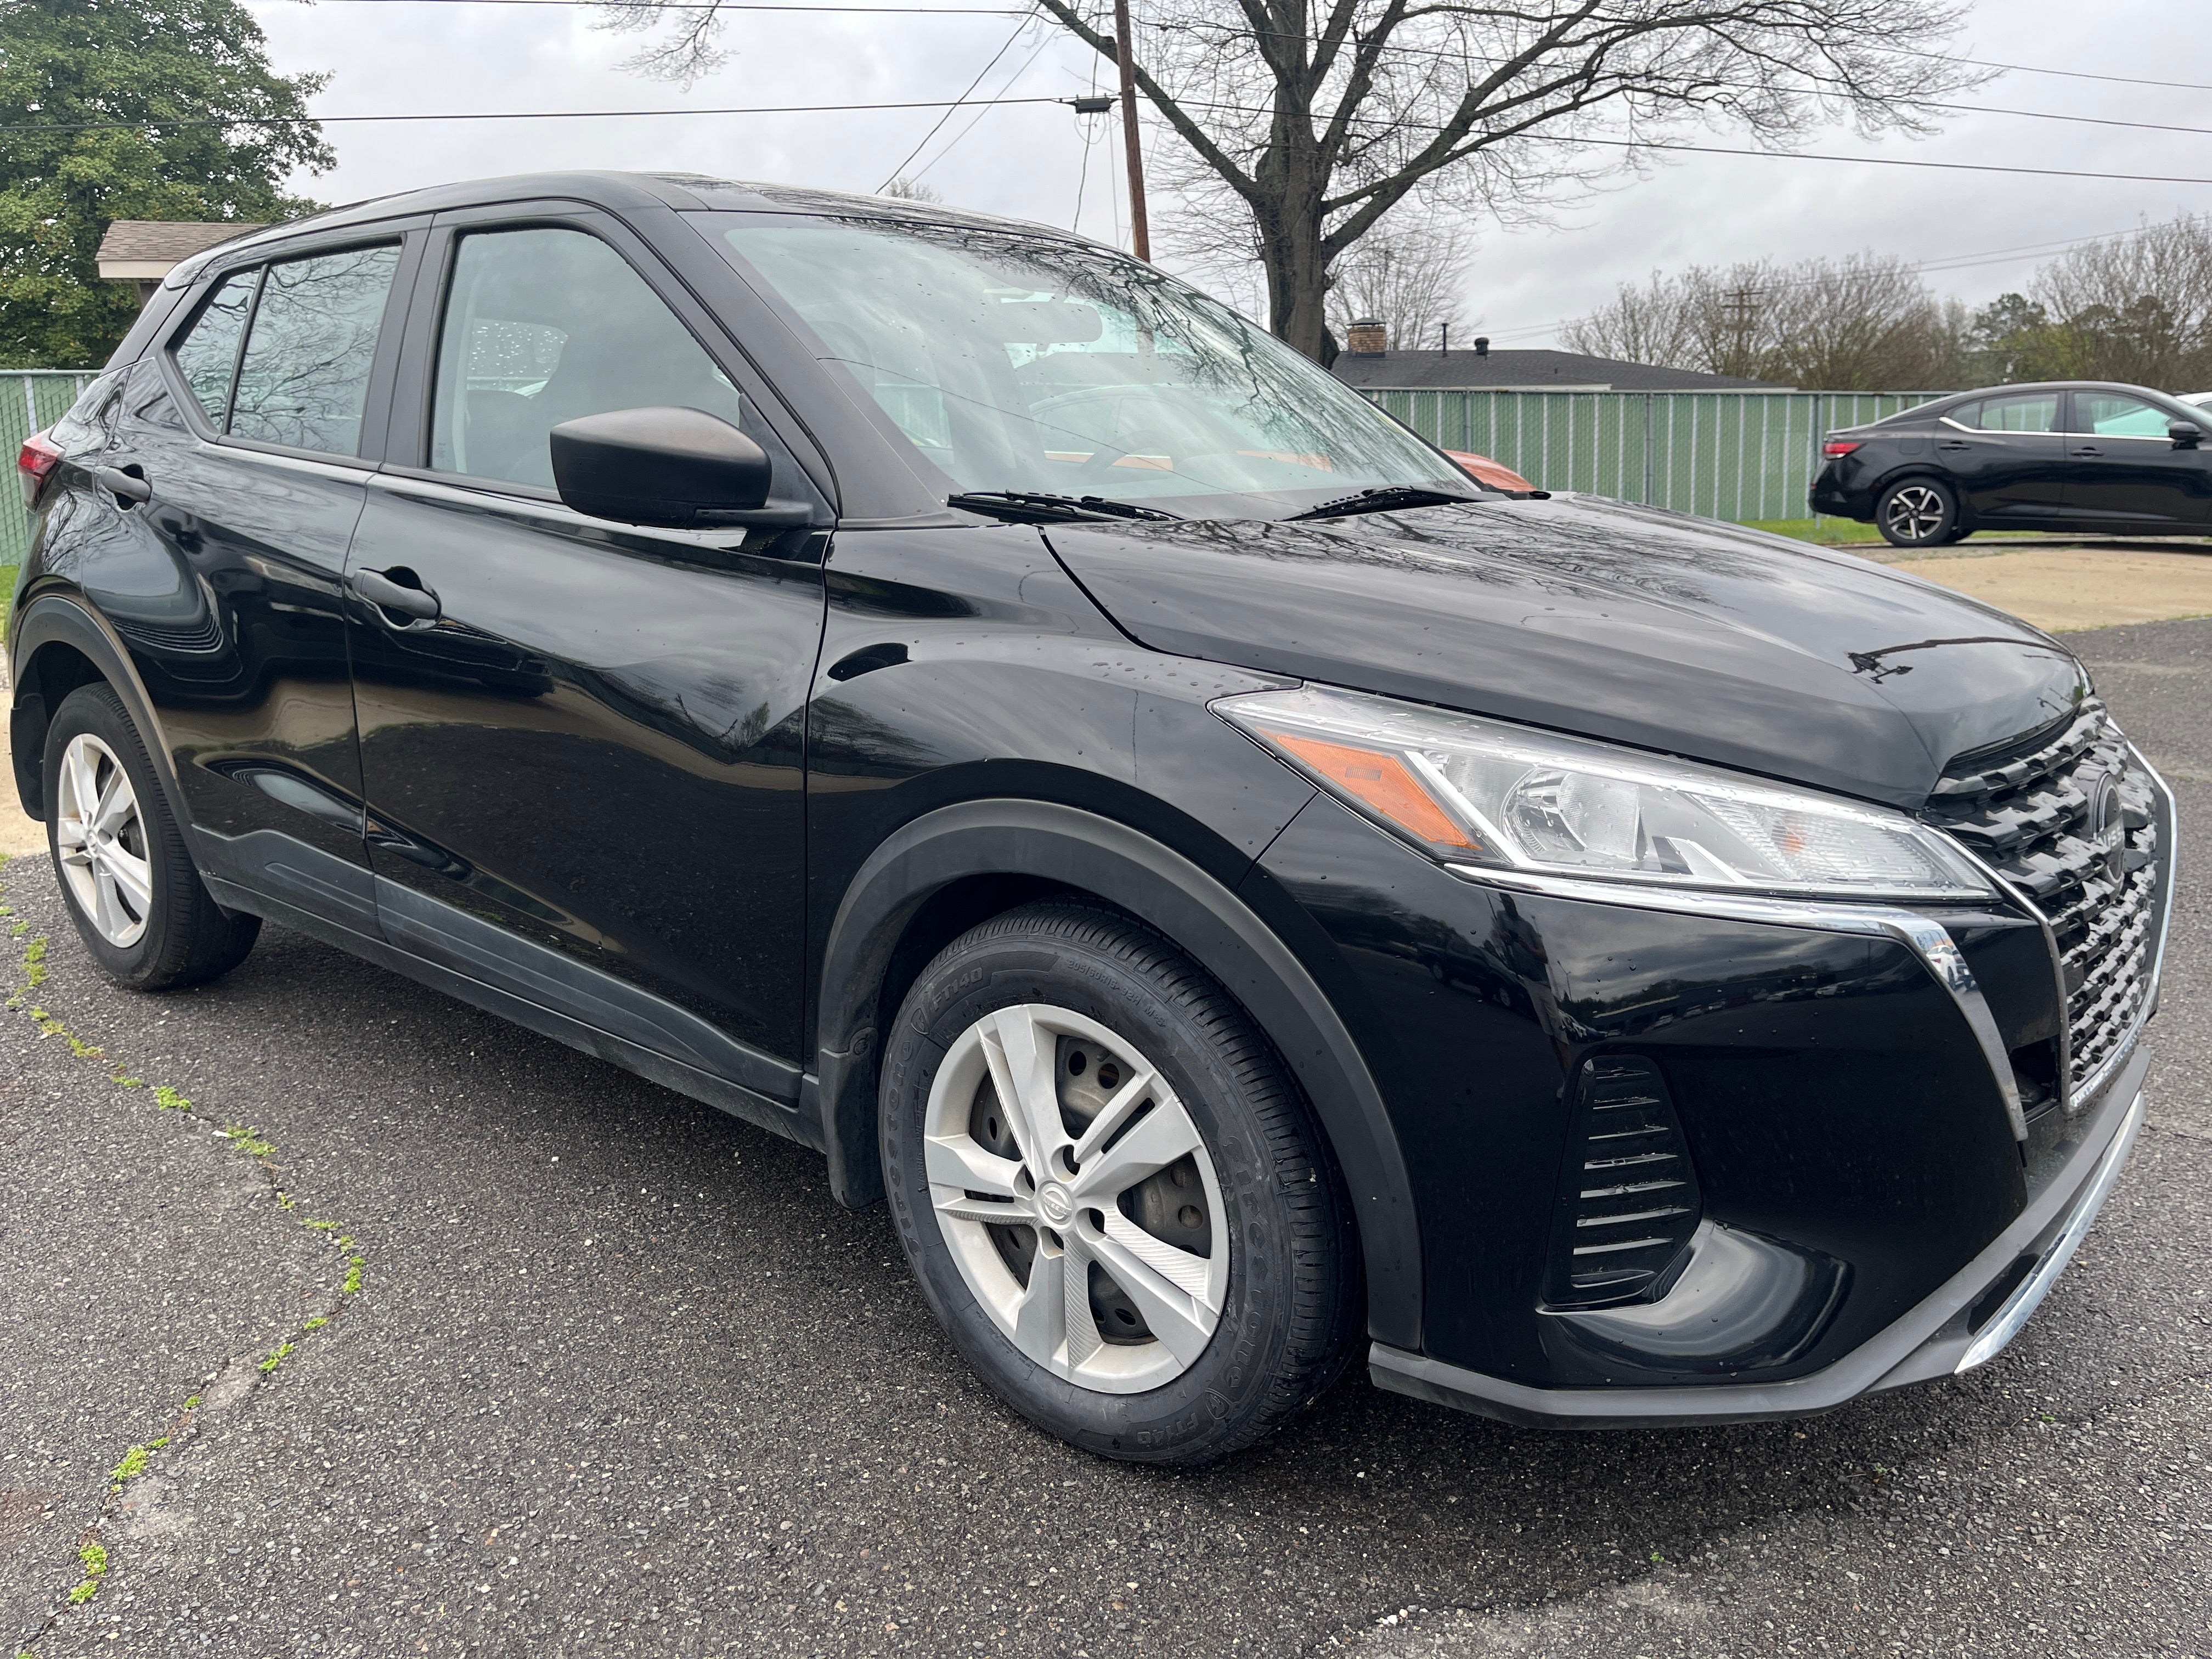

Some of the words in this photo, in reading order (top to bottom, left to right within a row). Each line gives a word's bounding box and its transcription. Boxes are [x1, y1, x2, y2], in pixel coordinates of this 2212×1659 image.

[932, 967, 983, 1011] FT140
[886, 1041, 919, 1256] Firestone
[1222, 1136, 1268, 1387] Firestone
[1137, 1413, 1199, 1444] FT140
